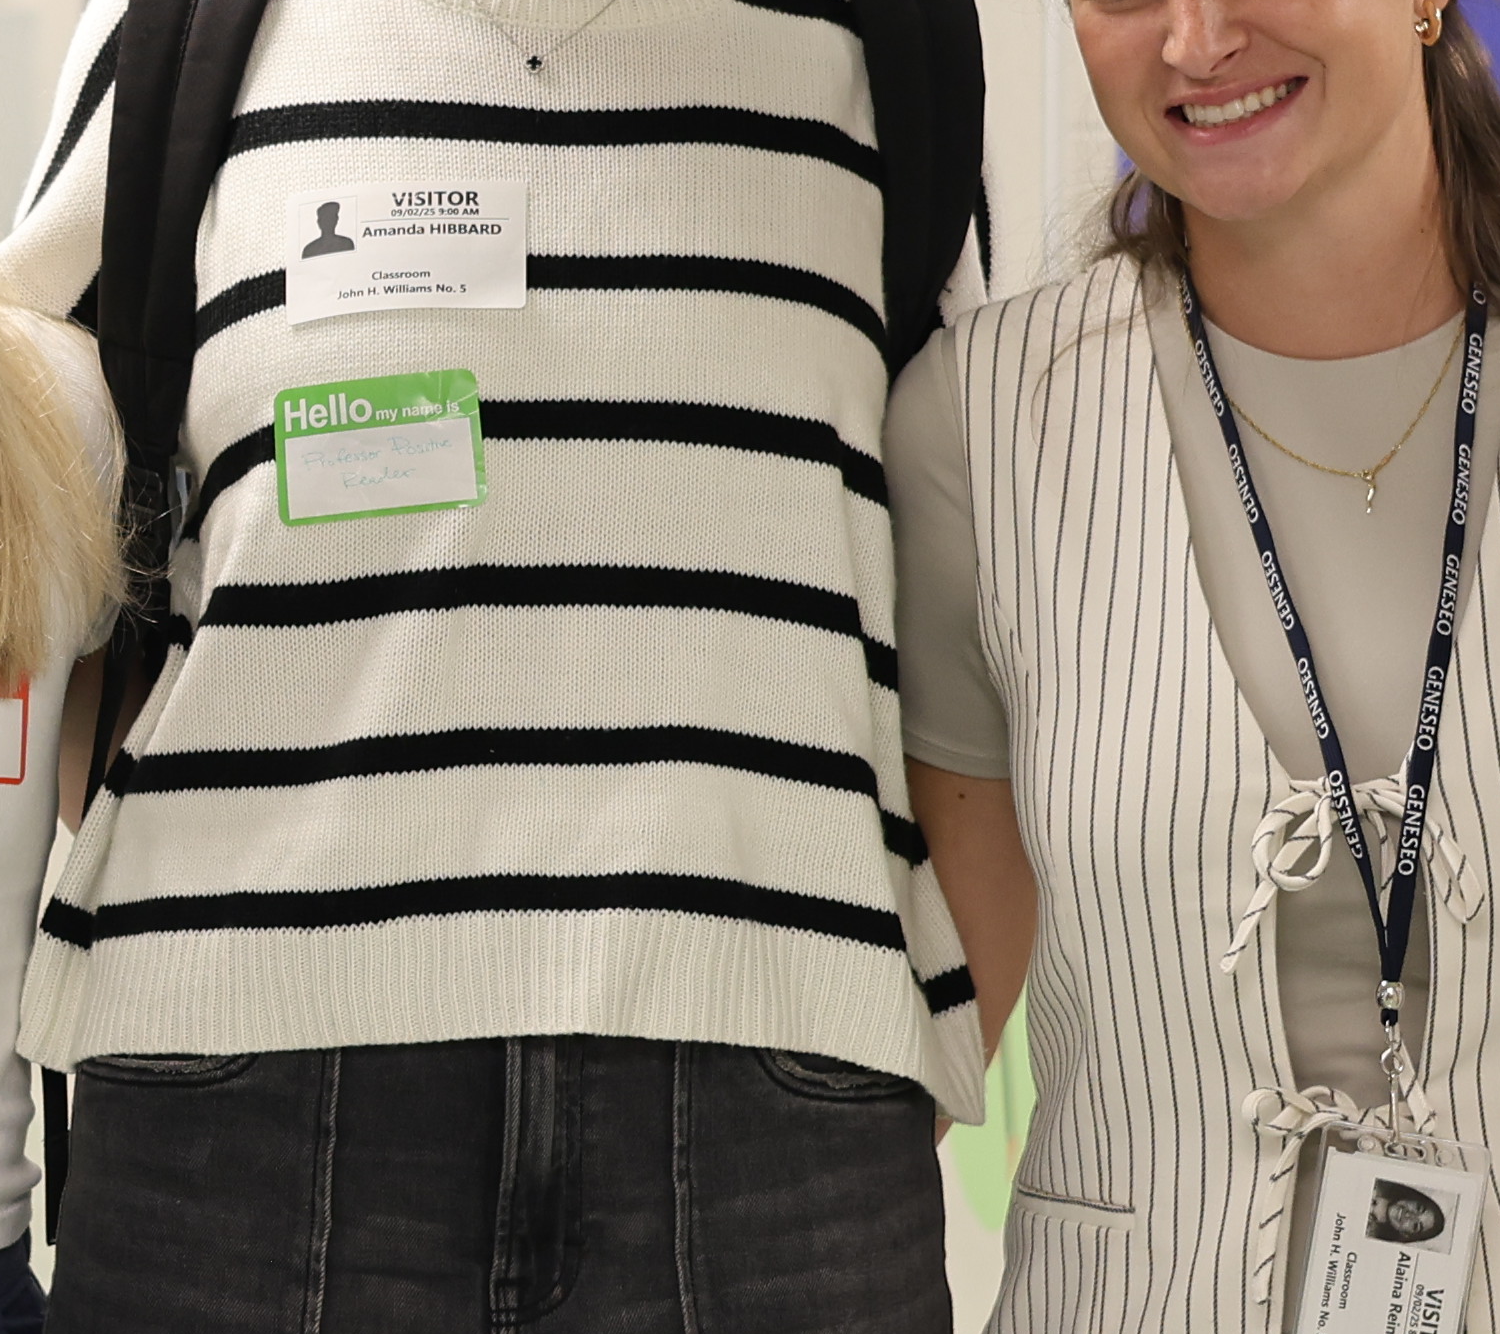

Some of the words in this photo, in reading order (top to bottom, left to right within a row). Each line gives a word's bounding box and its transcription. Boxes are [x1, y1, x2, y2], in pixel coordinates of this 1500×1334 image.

[391, 208, 436, 217] 09/02/25
[438, 208, 459, 216] 9:00
[462, 208, 479, 216] AM
[392, 190, 479, 207] VISITOR
[362, 224, 425, 238] Amanda
[429, 223, 502, 235] HIBBARD
[338, 288, 364, 300] John
[367, 287, 379, 296] H.
[383, 284, 432, 295] Williams
[436, 284, 456, 293] No.
[459, 284, 467, 293] 5
[372, 270, 431, 280] Classroom
[1195, 339, 1225, 417] GENESEO
[1461, 332, 1483, 414] GENESEO
[284, 393, 373, 432] Hello
[375, 409, 402, 422] my
[402, 403, 443, 417] name
[446, 400, 460, 413] is
[1228, 443, 1259, 524] GENESEO
[1451, 443, 1471, 525] GENESEO
[1261, 550, 1295, 631] GENESEO
[1436, 554, 1460, 636] GENESEO
[1297, 657, 1330, 740] GENESEO
[1416, 666, 1444, 752] GENESEO
[1329, 770, 1364, 859] GENESEO
[1398, 783, 1426, 876] GENESEO
[1331, 1243, 1341, 1257] H.
[1333, 1213, 1346, 1242] John
[1321, 1258, 1339, 1310] Williams
[1338, 1251, 1357, 1310] Classroom
[1391, 1251, 1411, 1306] Alaina
[1409, 1284, 1425, 1328] 09/02/25
[1318, 1311, 1330, 1330] No.
